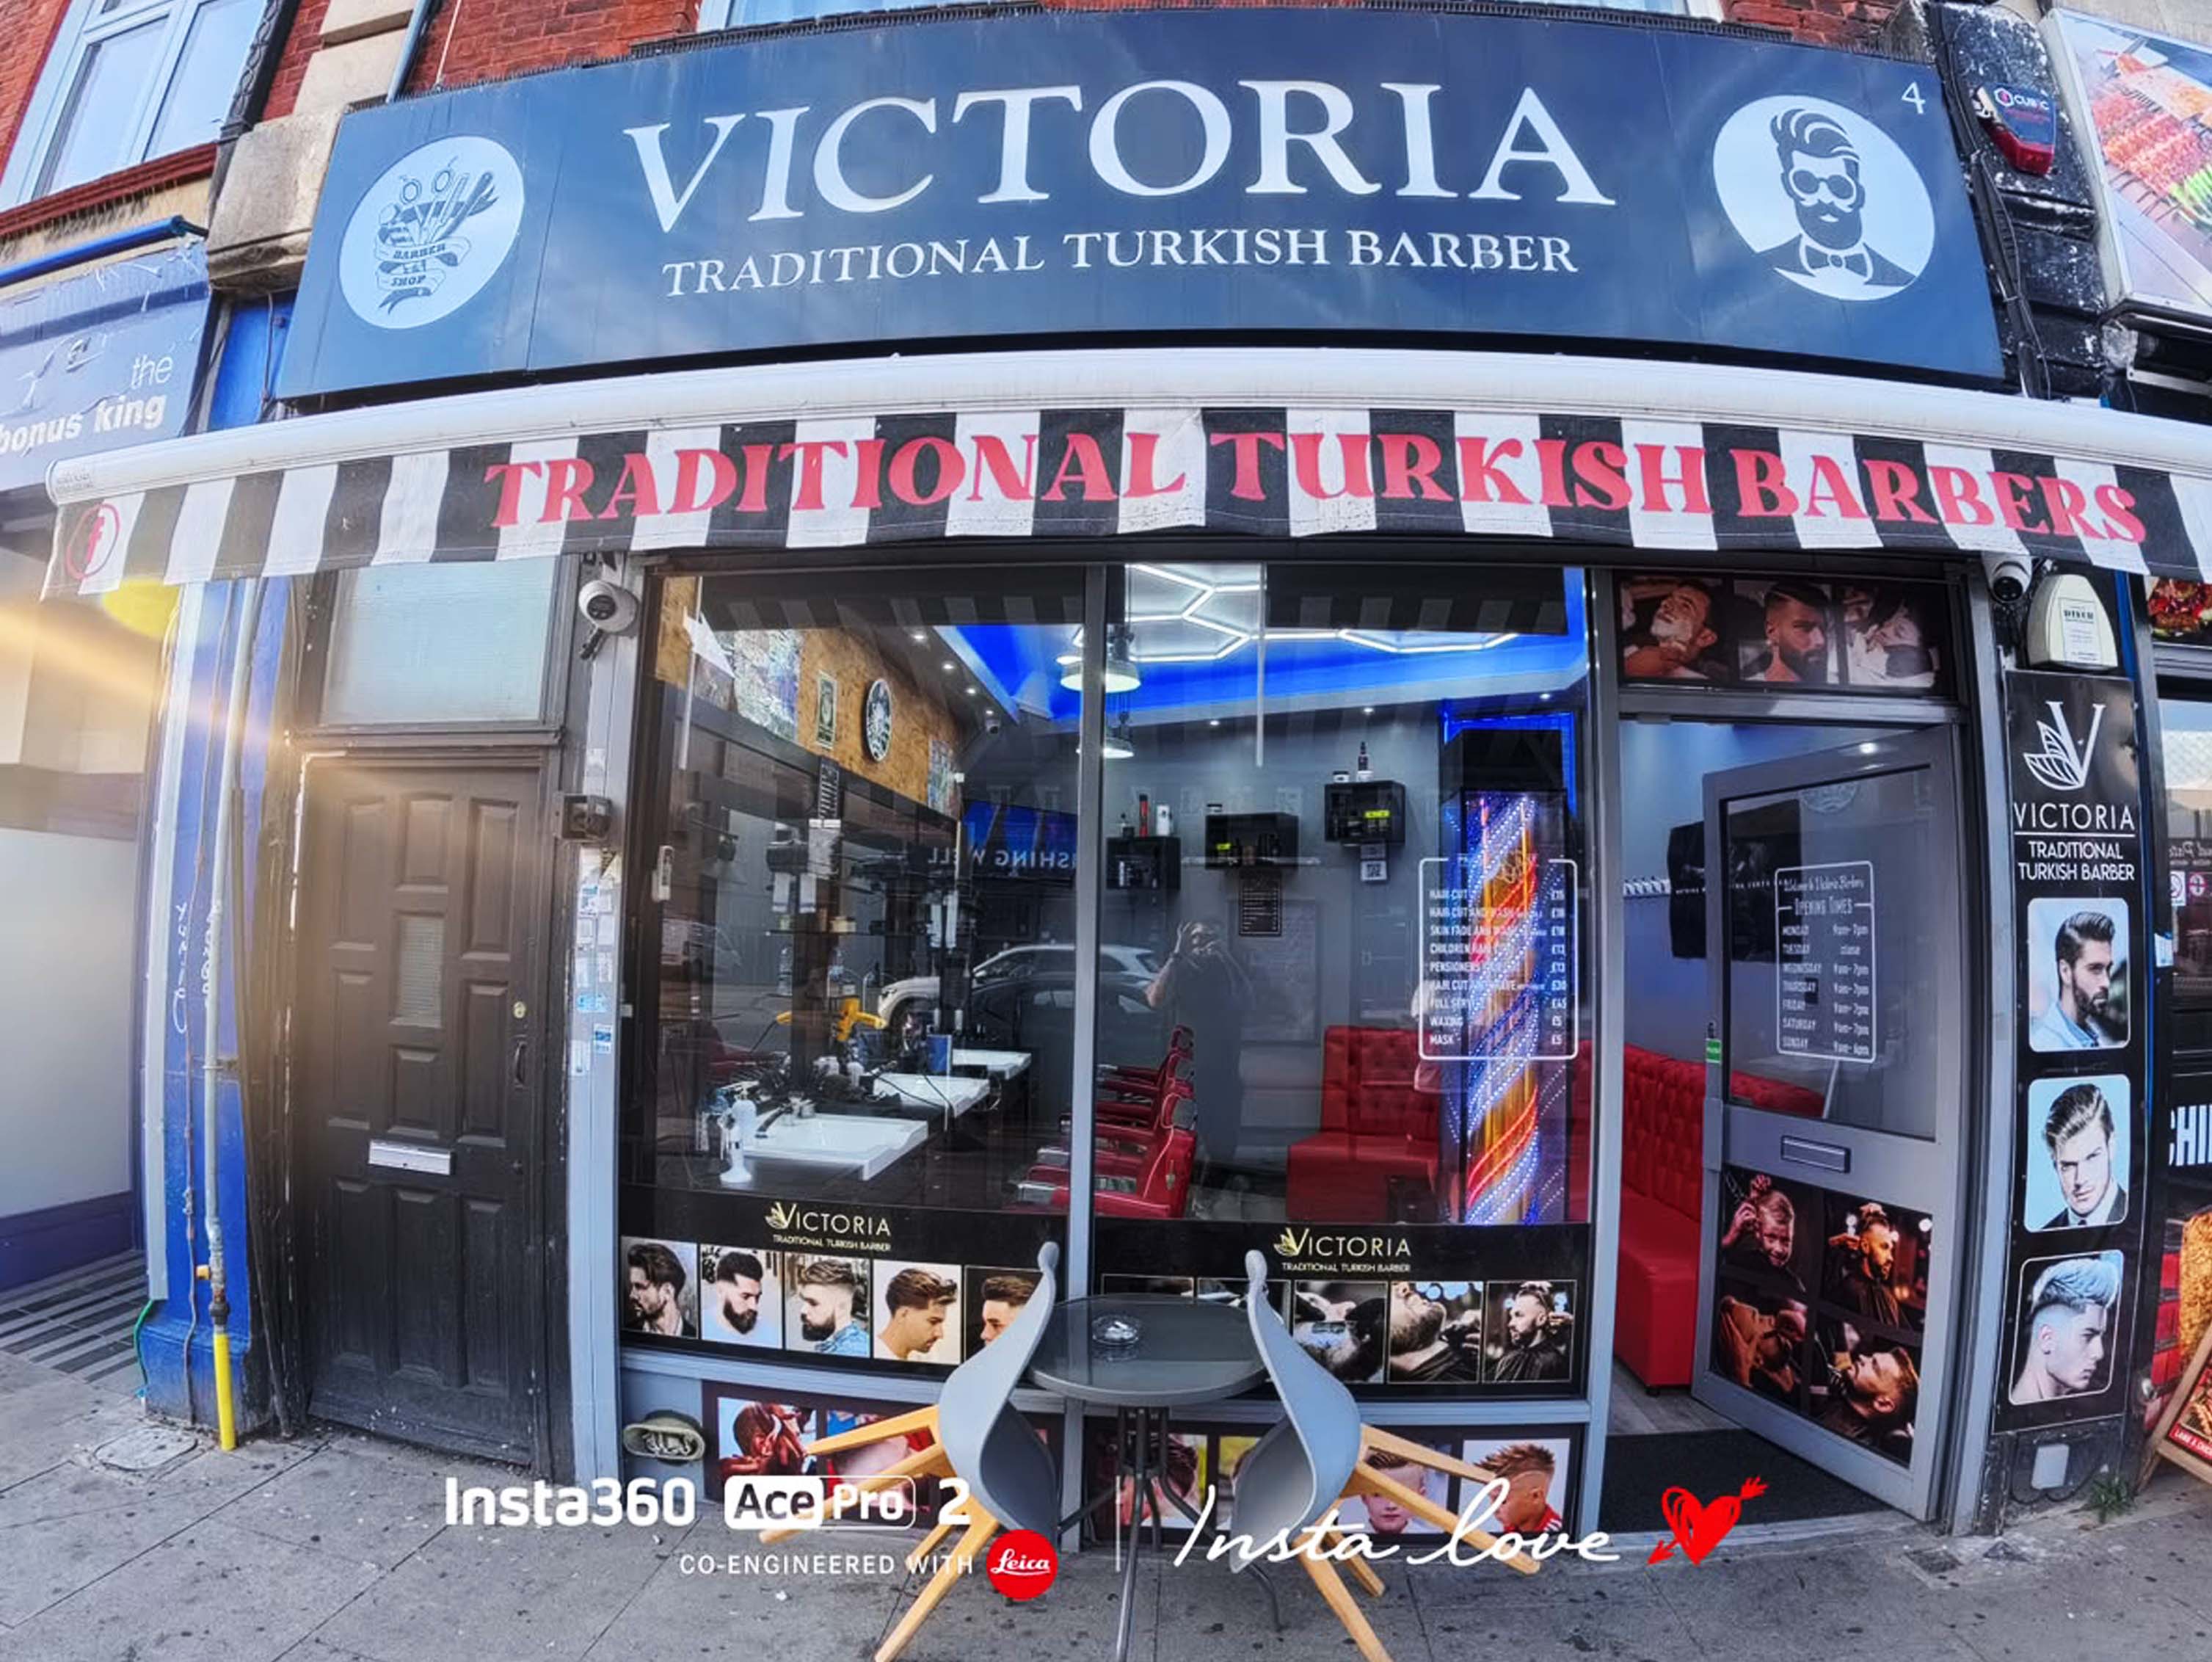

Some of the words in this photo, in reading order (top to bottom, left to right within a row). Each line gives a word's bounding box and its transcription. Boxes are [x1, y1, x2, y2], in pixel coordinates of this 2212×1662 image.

[1902, 82, 1926, 115] 4
[622, 80, 1615, 233] VICTORIA
[663, 236, 1044, 297] TRADITIONAL
[1063, 228, 1330, 269] TURKISH
[1346, 229, 1579, 273] BARBER
[390, 275, 426, 287] SHOP
[131, 352, 173, 390] the
[93, 394, 167, 433] king
[484, 432, 1186, 529] TRADITIONAL
[1209, 432, 1714, 515] TURKISH
[1729, 448, 2147, 544] BARBERS
[2014, 802, 2135, 830] VICTORIA
[2029, 841, 2123, 860] TRADITIONAL
[2018, 863, 2077, 880] TURKISH
[2081, 864, 2135, 881] BARBER
[775, 1201, 891, 1237] VICTORIA
[773, 1234, 823, 1247] TRADITIONAL
[826, 1238, 858, 1249] TURKISH
[861, 1242, 891, 1252] BARBER
[1285, 1227, 1411, 1257] VICTORIA
[1282, 1262, 1338, 1272] TRADITIONAL
[1342, 1263, 1375, 1272] TURKISH
[1377, 1263, 1411, 1273] BARBER
